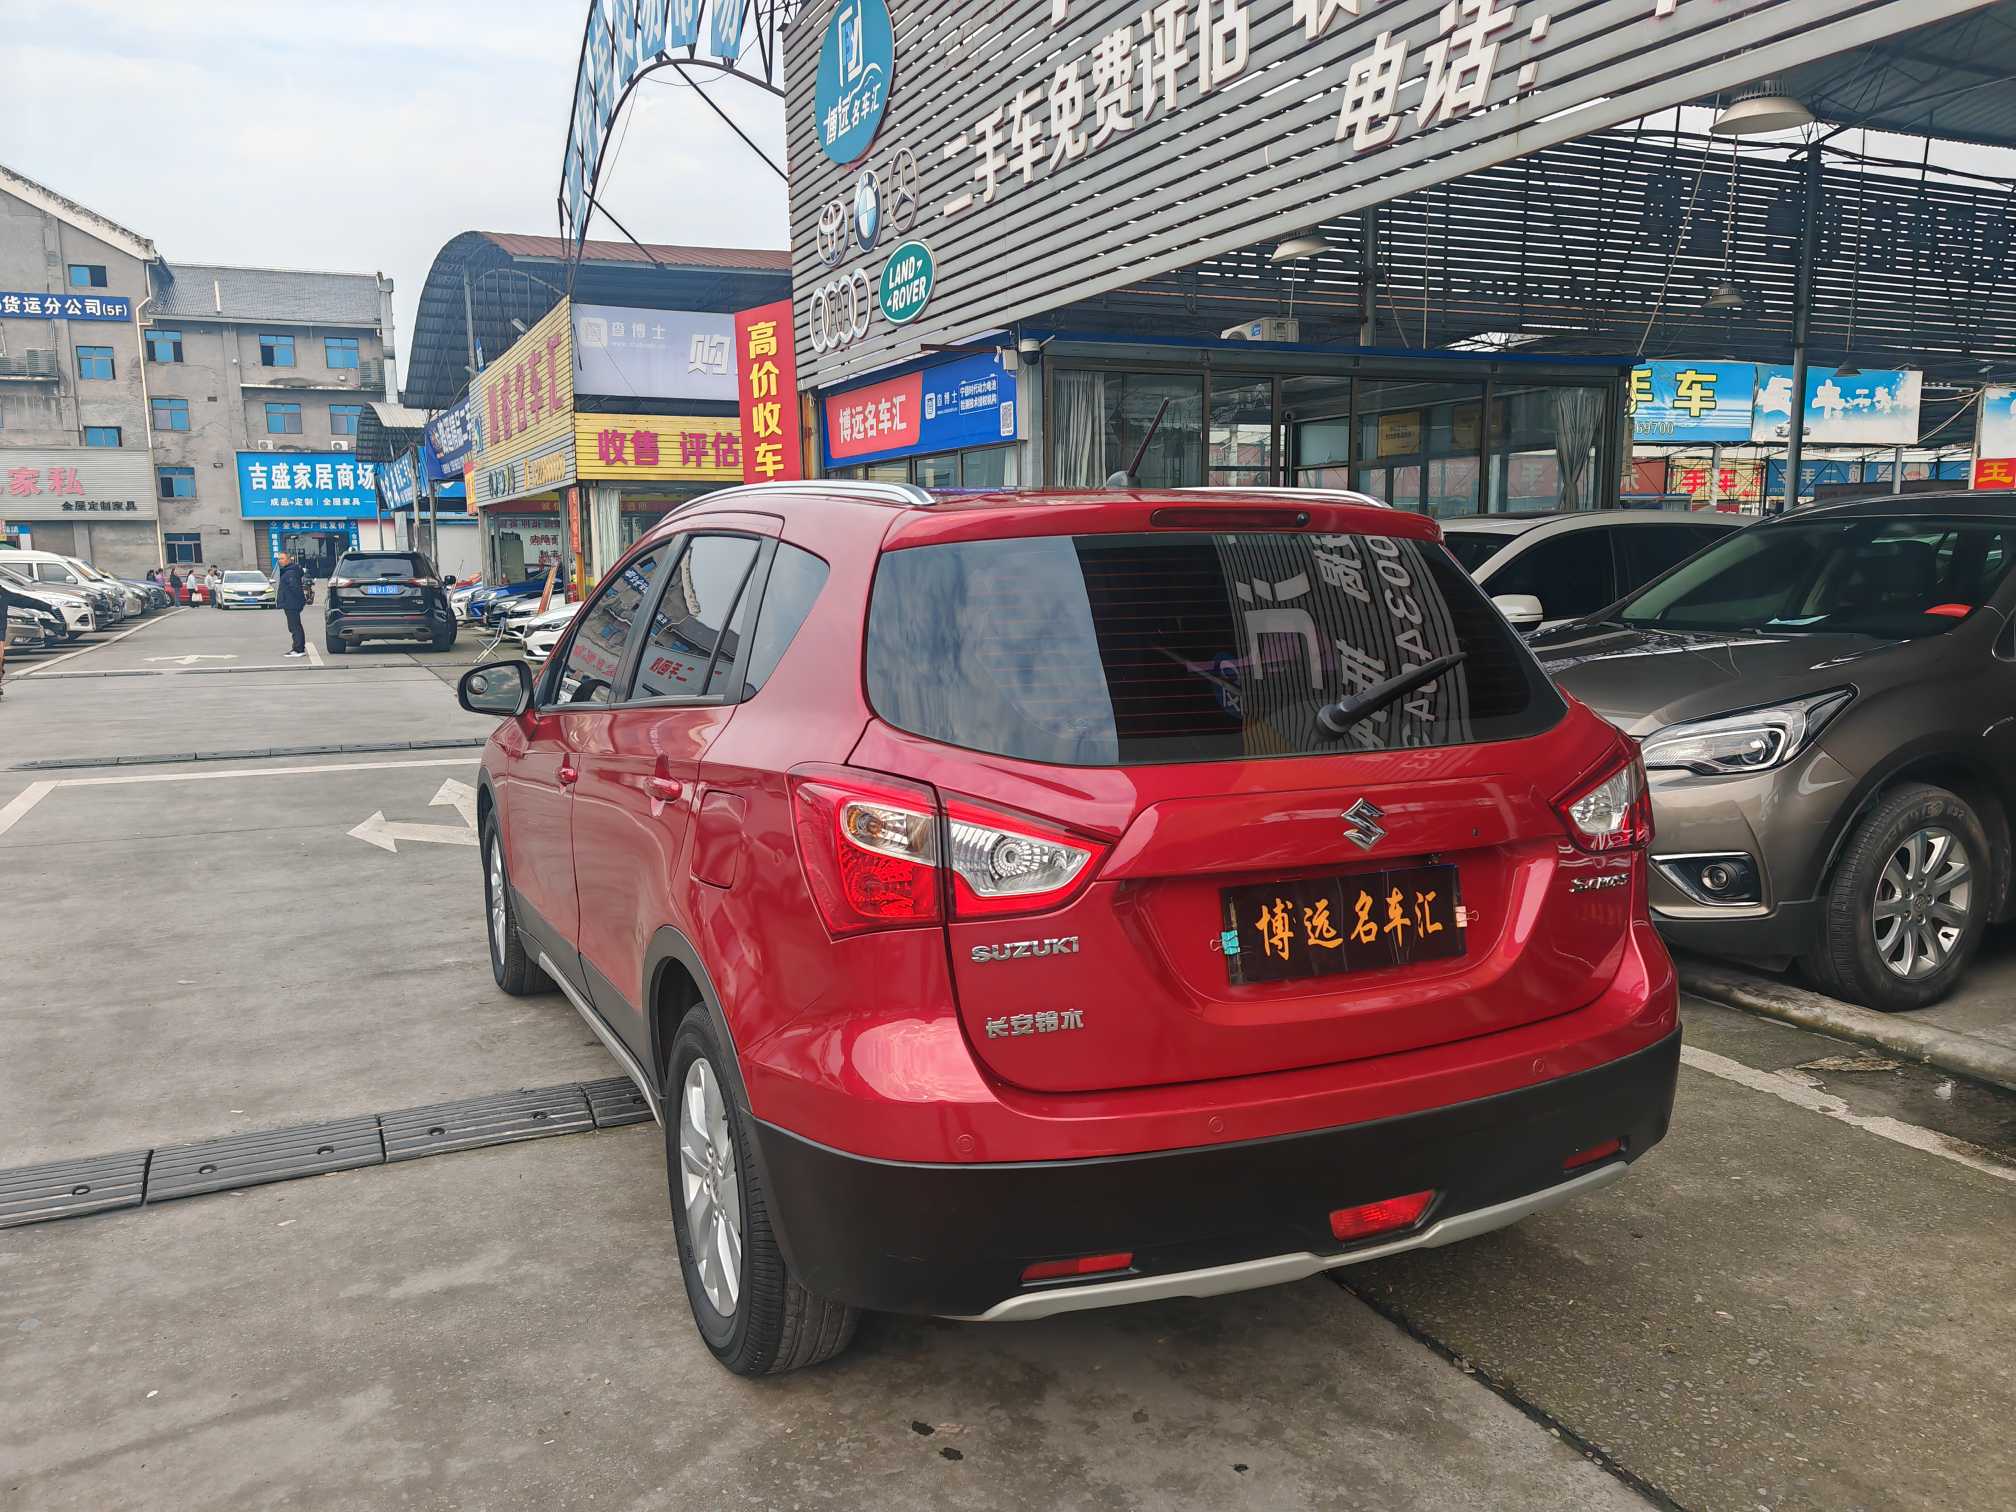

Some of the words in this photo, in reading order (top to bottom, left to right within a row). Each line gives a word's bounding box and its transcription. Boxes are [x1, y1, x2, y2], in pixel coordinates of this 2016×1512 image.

[888, 256, 917, 290] LAND
[0, 295, 127, 316] 货运分公司(5F)
[891, 274, 927, 313] ROVER
[747, 320, 784, 477] 高价收车
[839, 394, 908, 444] 博远名车汇
[679, 431, 740, 467] 评估
[0, 465, 86, 497] 家私
[248, 462, 377, 491] 吉盛家居商场
[1254, 886, 1444, 961] 博远名车汇
[971, 935, 1081, 963] SUZUKI
[985, 1008, 1085, 1039] 长安铃木
